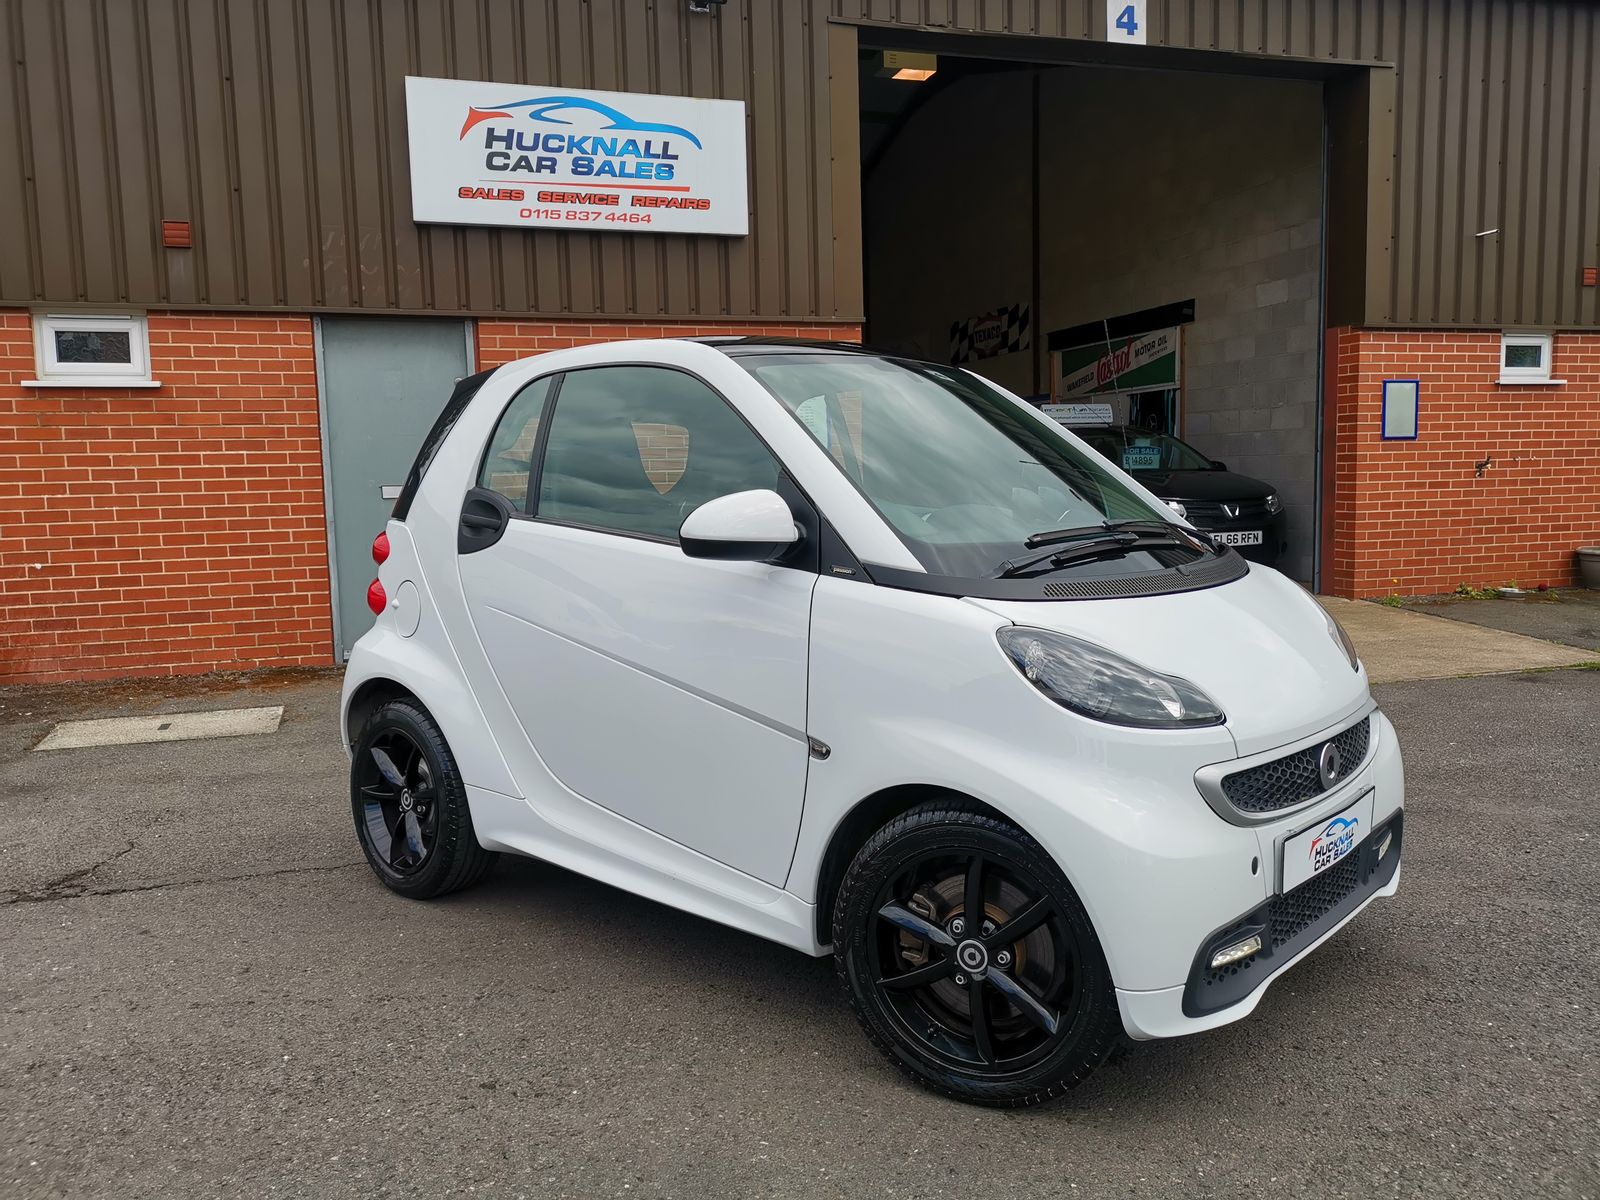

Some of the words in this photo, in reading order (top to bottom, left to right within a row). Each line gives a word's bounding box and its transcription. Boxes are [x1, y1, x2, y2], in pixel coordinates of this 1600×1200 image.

[1116, 5, 1138, 35] 4
[485, 127, 679, 161] HUCKNALL
[485, 151, 558, 174] CAR
[571, 156, 675, 181] SALES
[458, 187, 525, 202] SALES
[537, 191, 620, 206] SERVICE
[631, 195, 711, 210] REPAIRS
[520, 208, 561, 220] 0115
[565, 210, 602, 222] 837
[605, 212, 652, 224] 4464
[974, 325, 1001, 344] TEXACO
[1066, 371, 1095, 392] WAKEFIELD
[1097, 336, 1134, 392] Castrol
[1134, 340, 1156, 358] MOTOR
[1157, 335, 1168, 347] OIL
[1140, 447, 1159, 455] SALE
[1241, 532, 1259, 543] RFN
[1314, 827, 1354, 860] HUCKNALL
[1314, 854, 1331, 872] CAR
[1333, 839, 1353, 861] SALES
